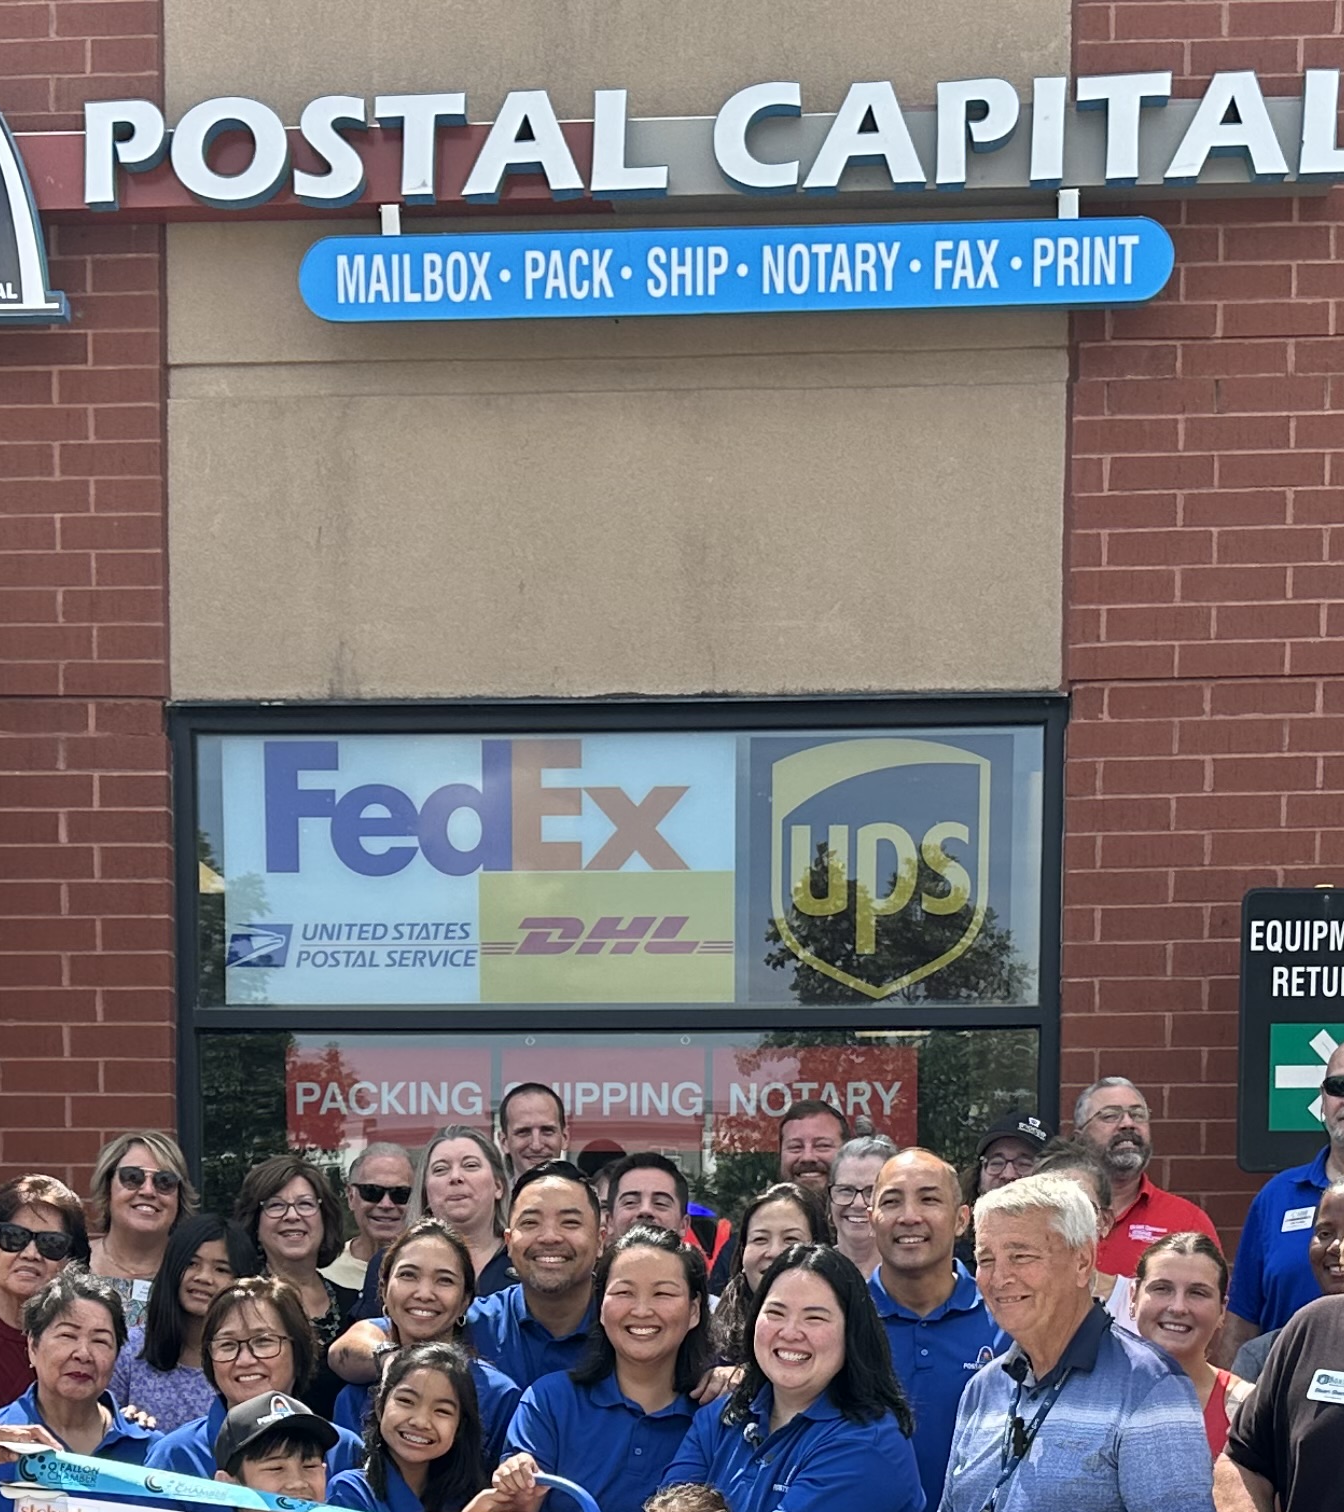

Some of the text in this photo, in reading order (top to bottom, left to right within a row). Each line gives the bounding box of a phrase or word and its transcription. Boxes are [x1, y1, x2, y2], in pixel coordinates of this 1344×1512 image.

[84, 88, 670, 207] POSTAL
[336, 234, 1140, 305] MAILBOX PACK SHIP NOTARY FAX PRINT
[264, 739, 691, 878] FedEx
[790, 822, 973, 957] ups
[296, 948, 478, 970] POSTAL SERVICE
[301, 922, 472, 942] UNITED STATES
[515, 916, 700, 956] DHL
[295, 1081, 904, 1118] PACKING IPPING NOTARY
